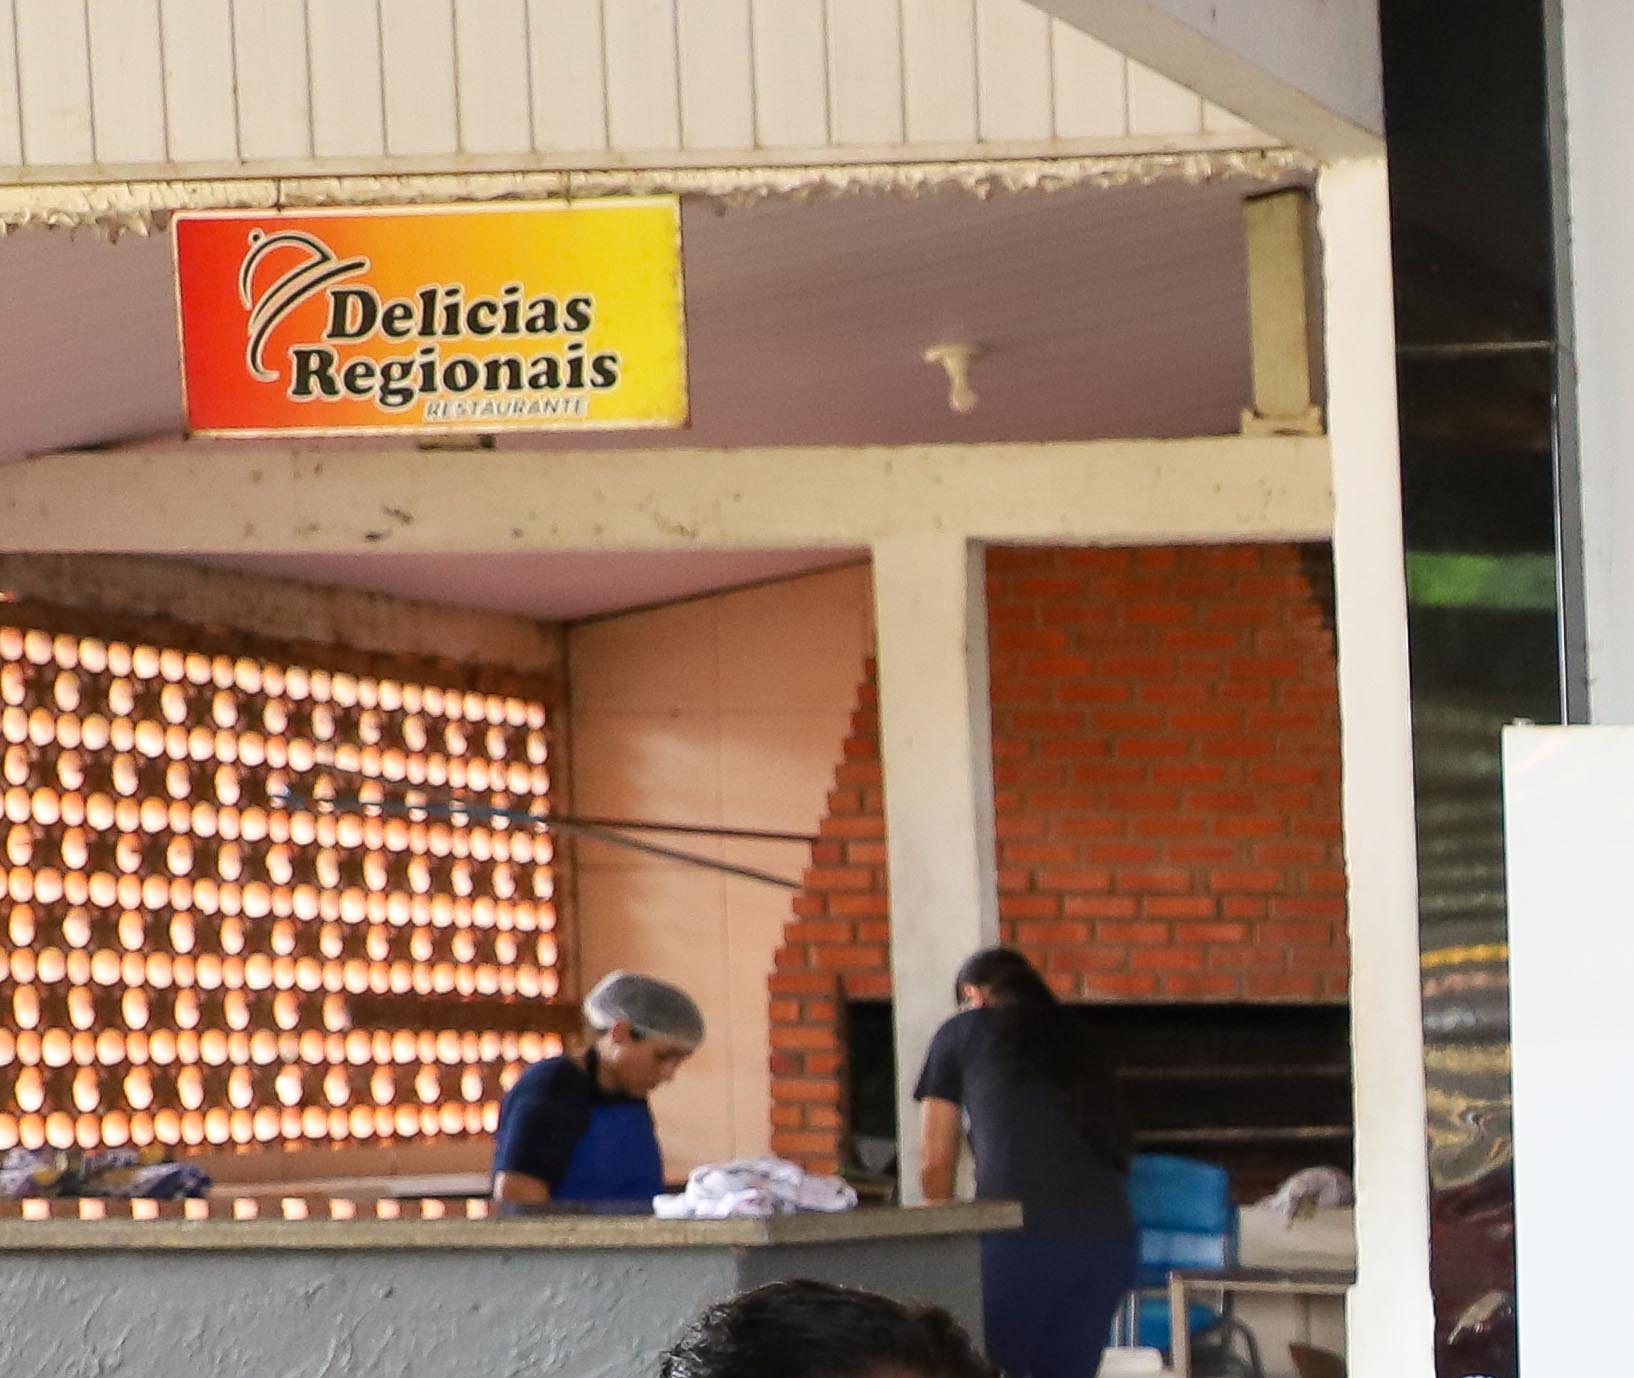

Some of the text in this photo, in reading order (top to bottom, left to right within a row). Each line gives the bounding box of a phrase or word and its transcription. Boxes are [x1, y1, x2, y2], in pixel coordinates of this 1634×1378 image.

[325, 286, 592, 340] Delicias
[290, 342, 620, 407] Regionais
[425, 398, 584, 419] RESTAURANTE
